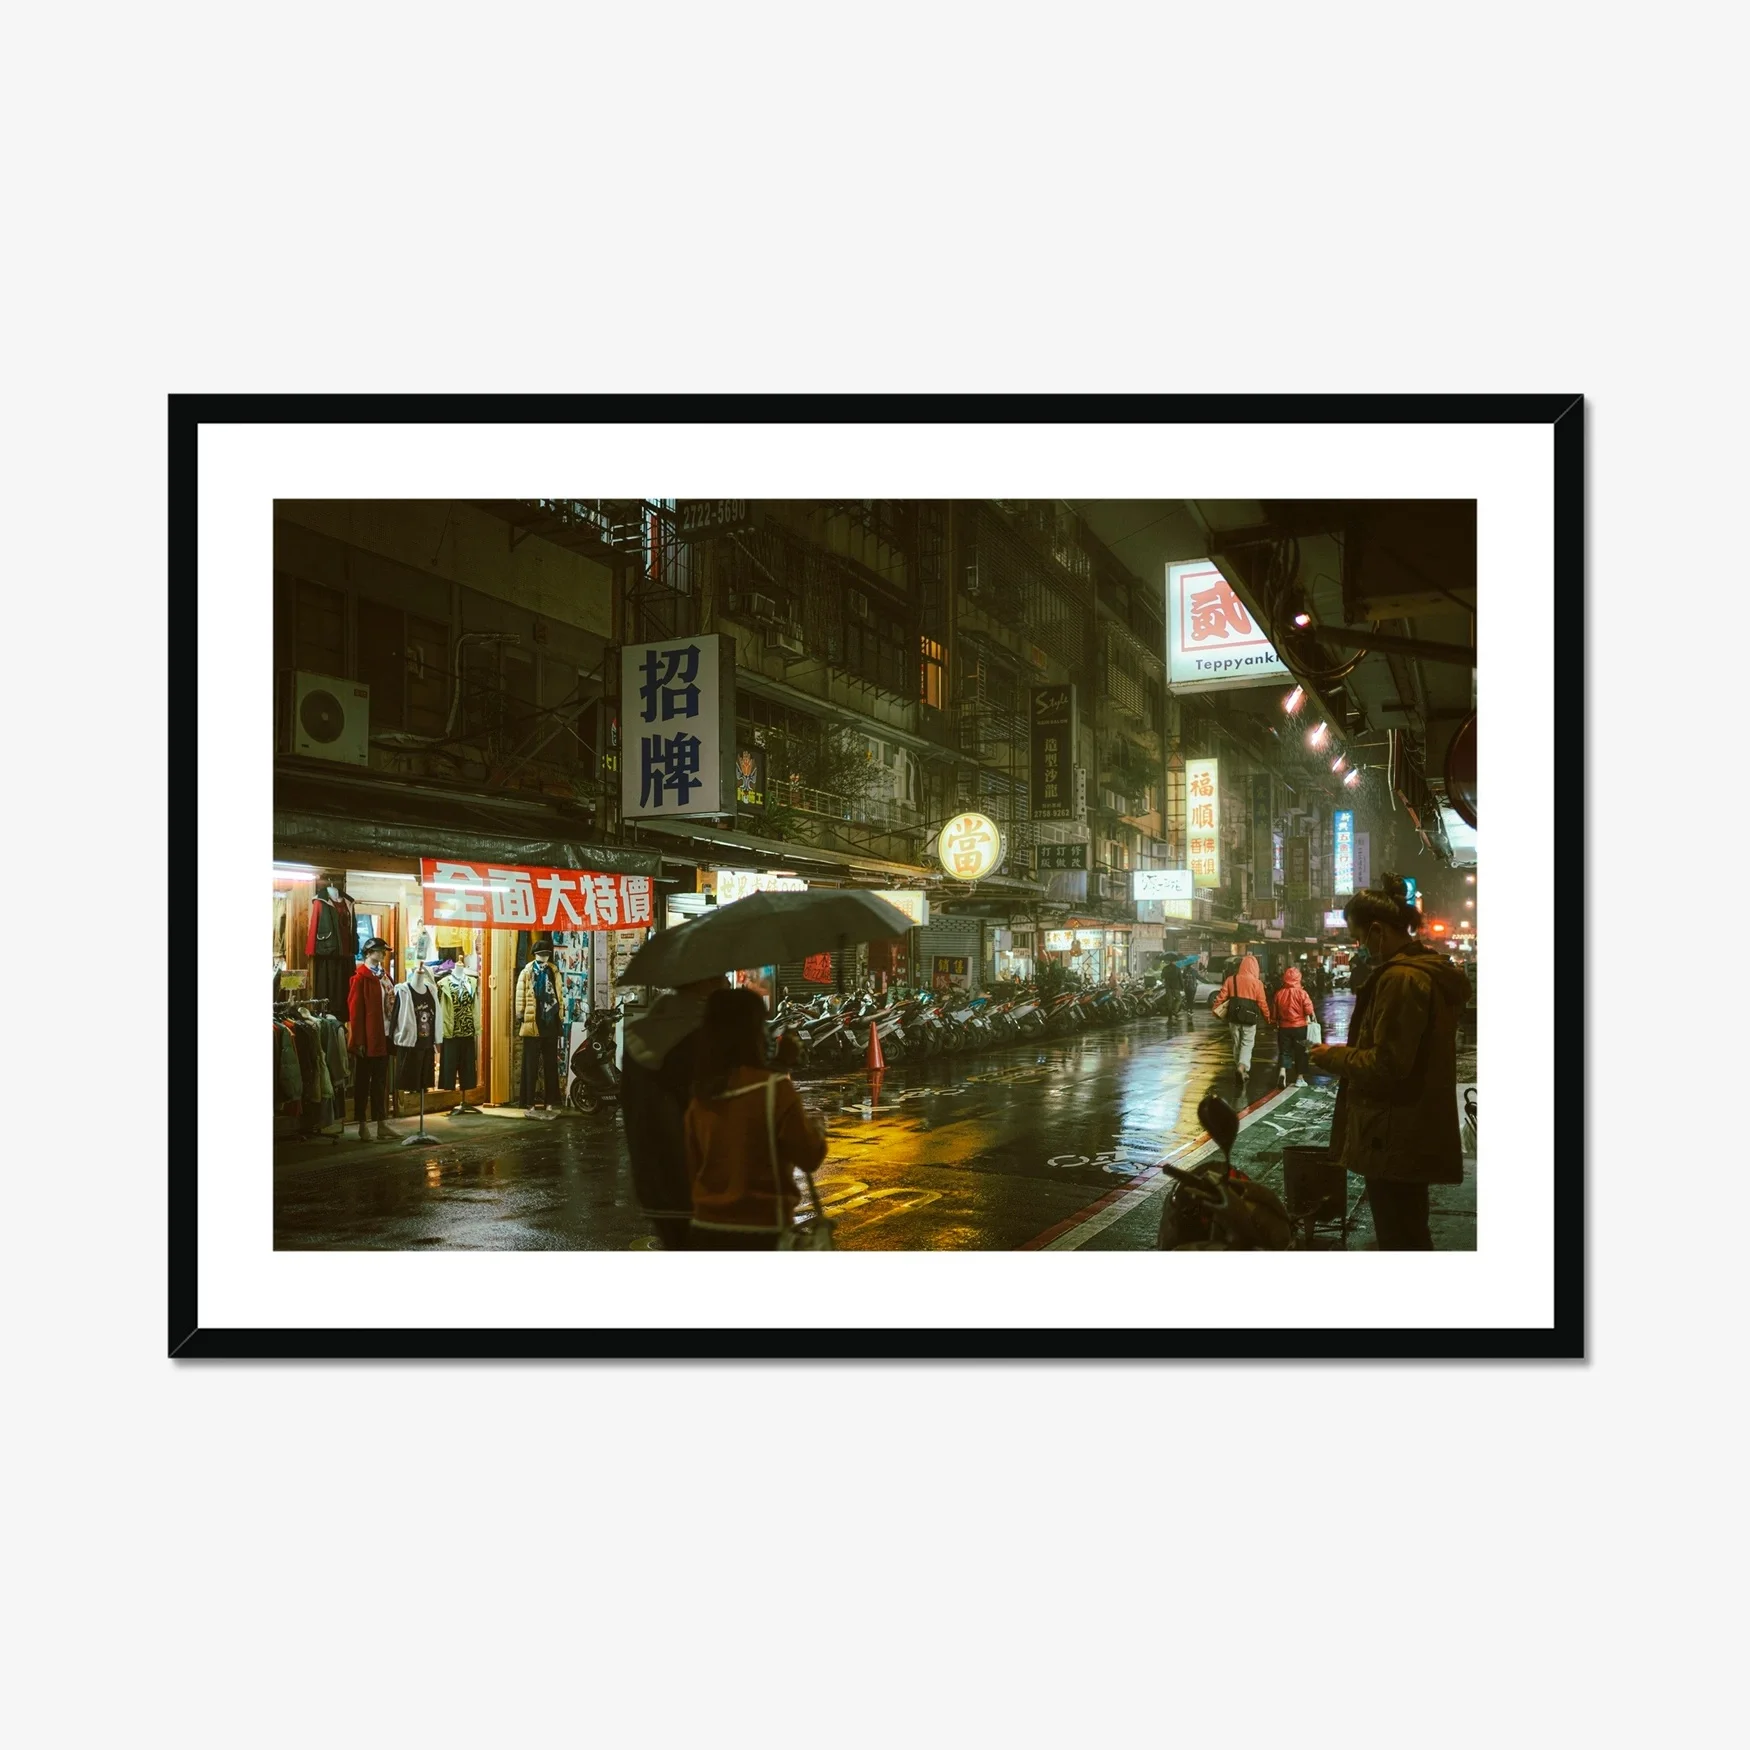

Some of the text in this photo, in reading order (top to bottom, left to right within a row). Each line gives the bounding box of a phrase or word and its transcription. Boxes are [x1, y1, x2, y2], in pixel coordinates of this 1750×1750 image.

[639, 644, 703, 808] 招牌
[1190, 771, 1216, 829] 福順
[947, 817, 991, 874] 當
[433, 861, 651, 926] 全面大特價
